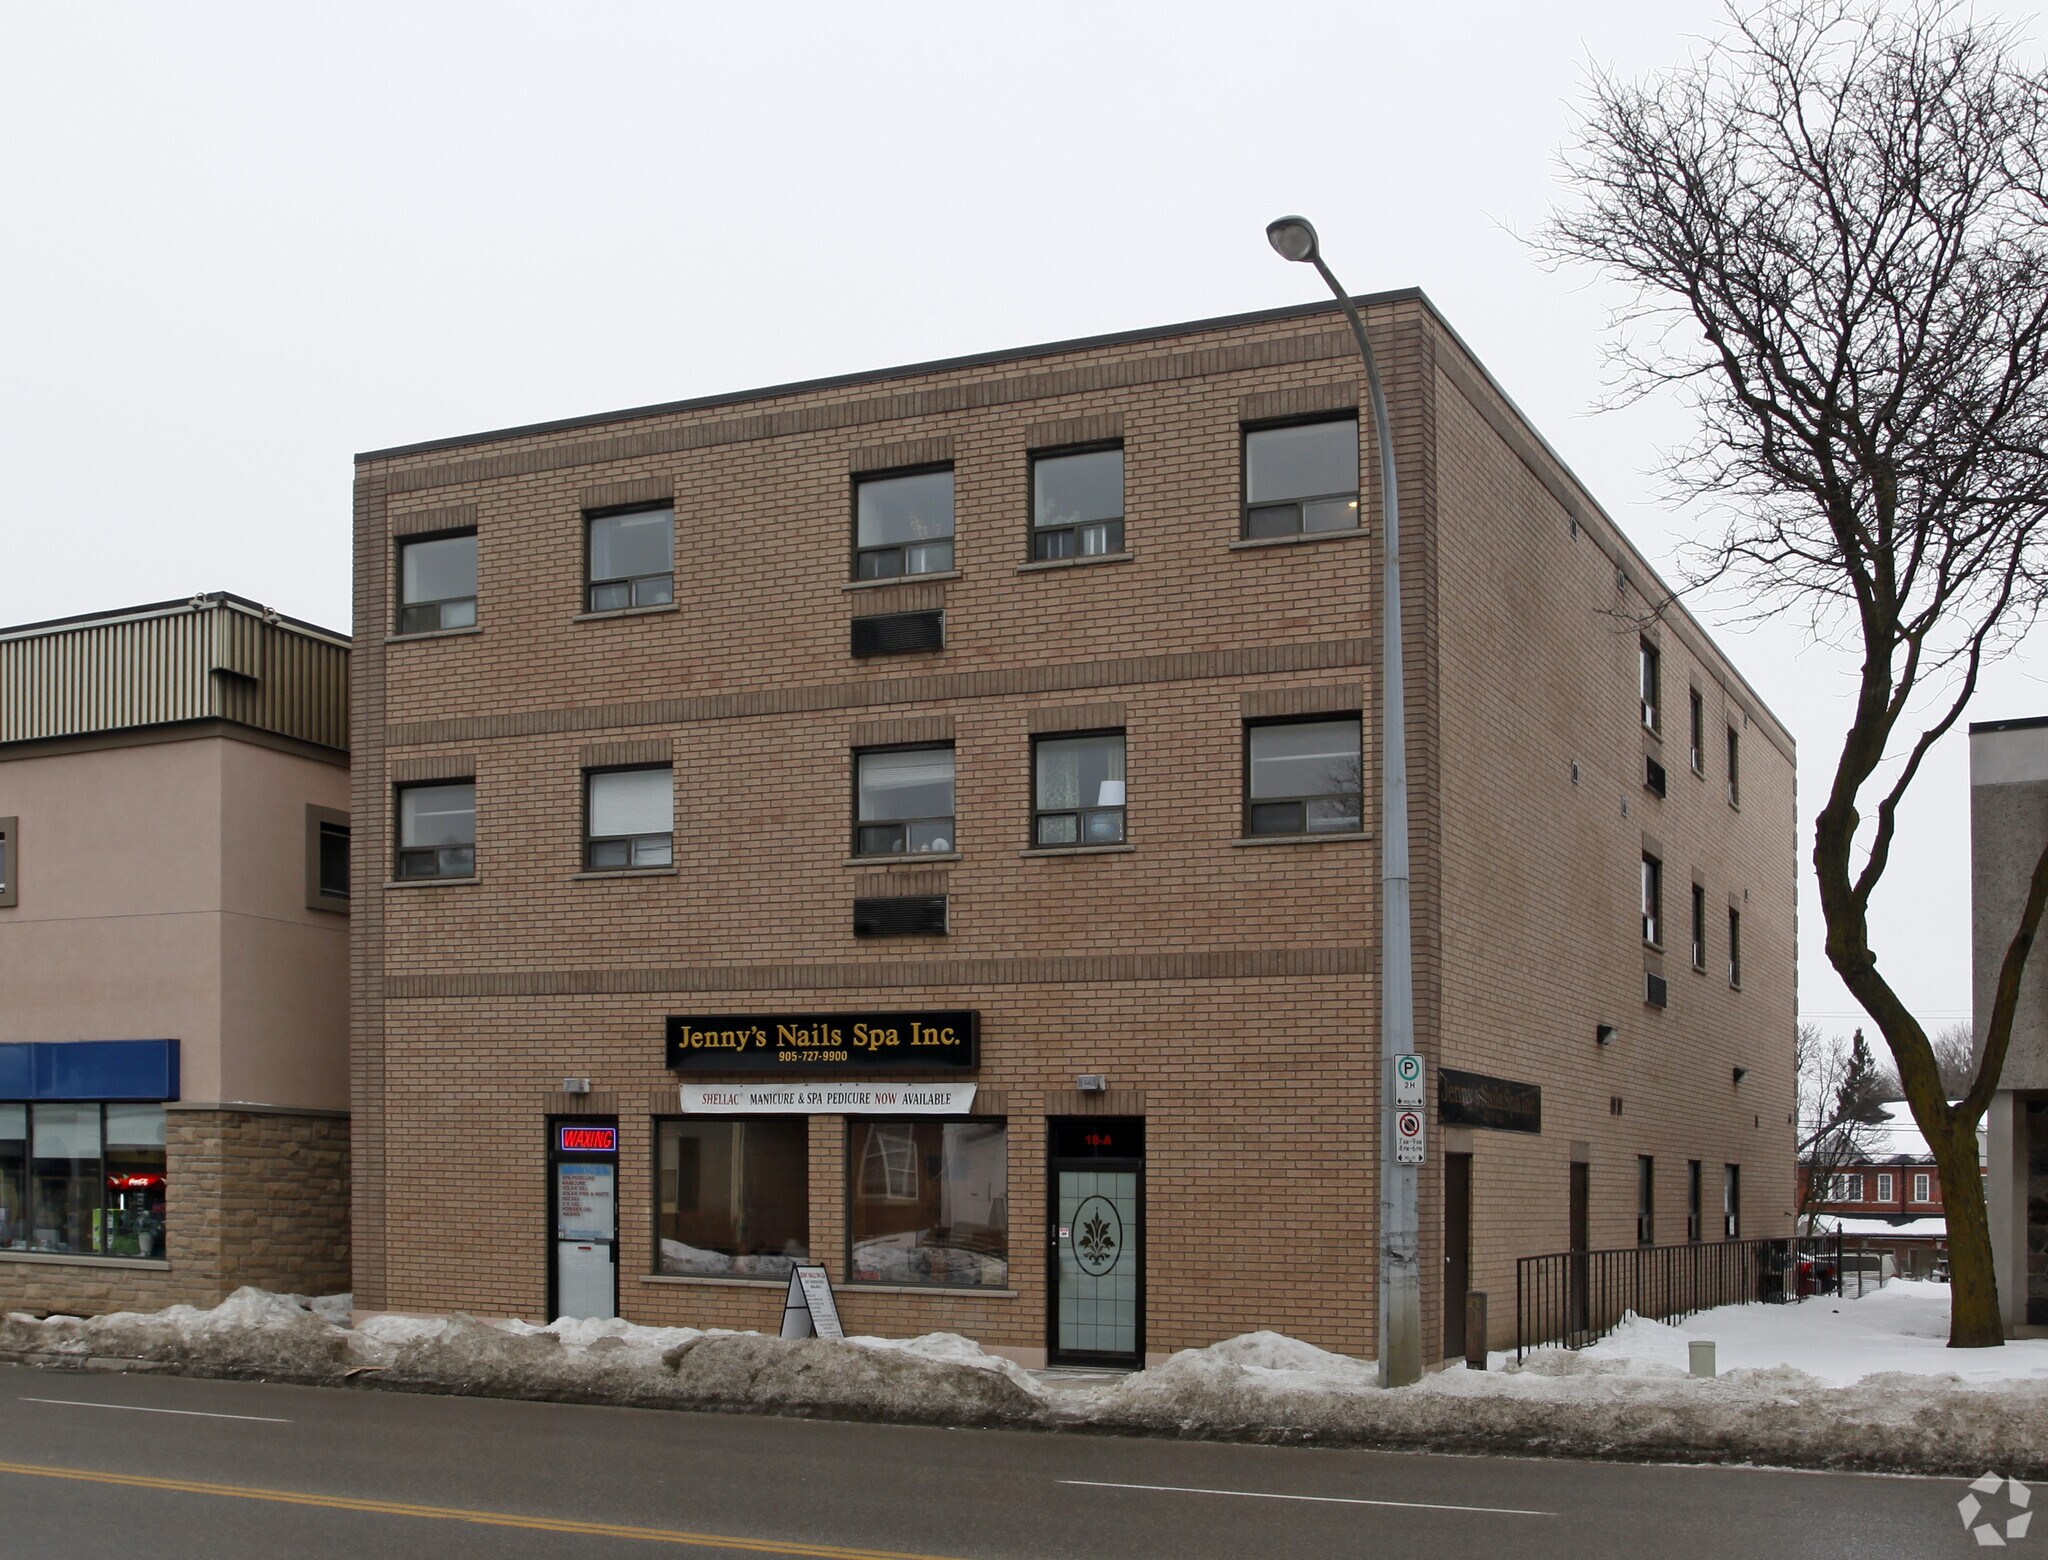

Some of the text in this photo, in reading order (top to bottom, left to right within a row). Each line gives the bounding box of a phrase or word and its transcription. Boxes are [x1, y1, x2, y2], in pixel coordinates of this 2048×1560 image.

[679, 1022, 960, 1051] Jenny's Nails Spa Inc.
[778, 1050, 848, 1062] 905-727-9900
[1404, 1061, 1414, 1075] P
[750, 1092, 795, 1105] MANICURE
[798, 1092, 805, 1104] &
[807, 1092, 823, 1104] SPA
[827, 1092, 871, 1104] PEDICURE
[875, 1092, 897, 1104] NOW
[902, 1093, 952, 1105] AVAILABLE
[564, 1130, 613, 1148] WAXING
[1084, 1134, 1112, 1146] 18-A
